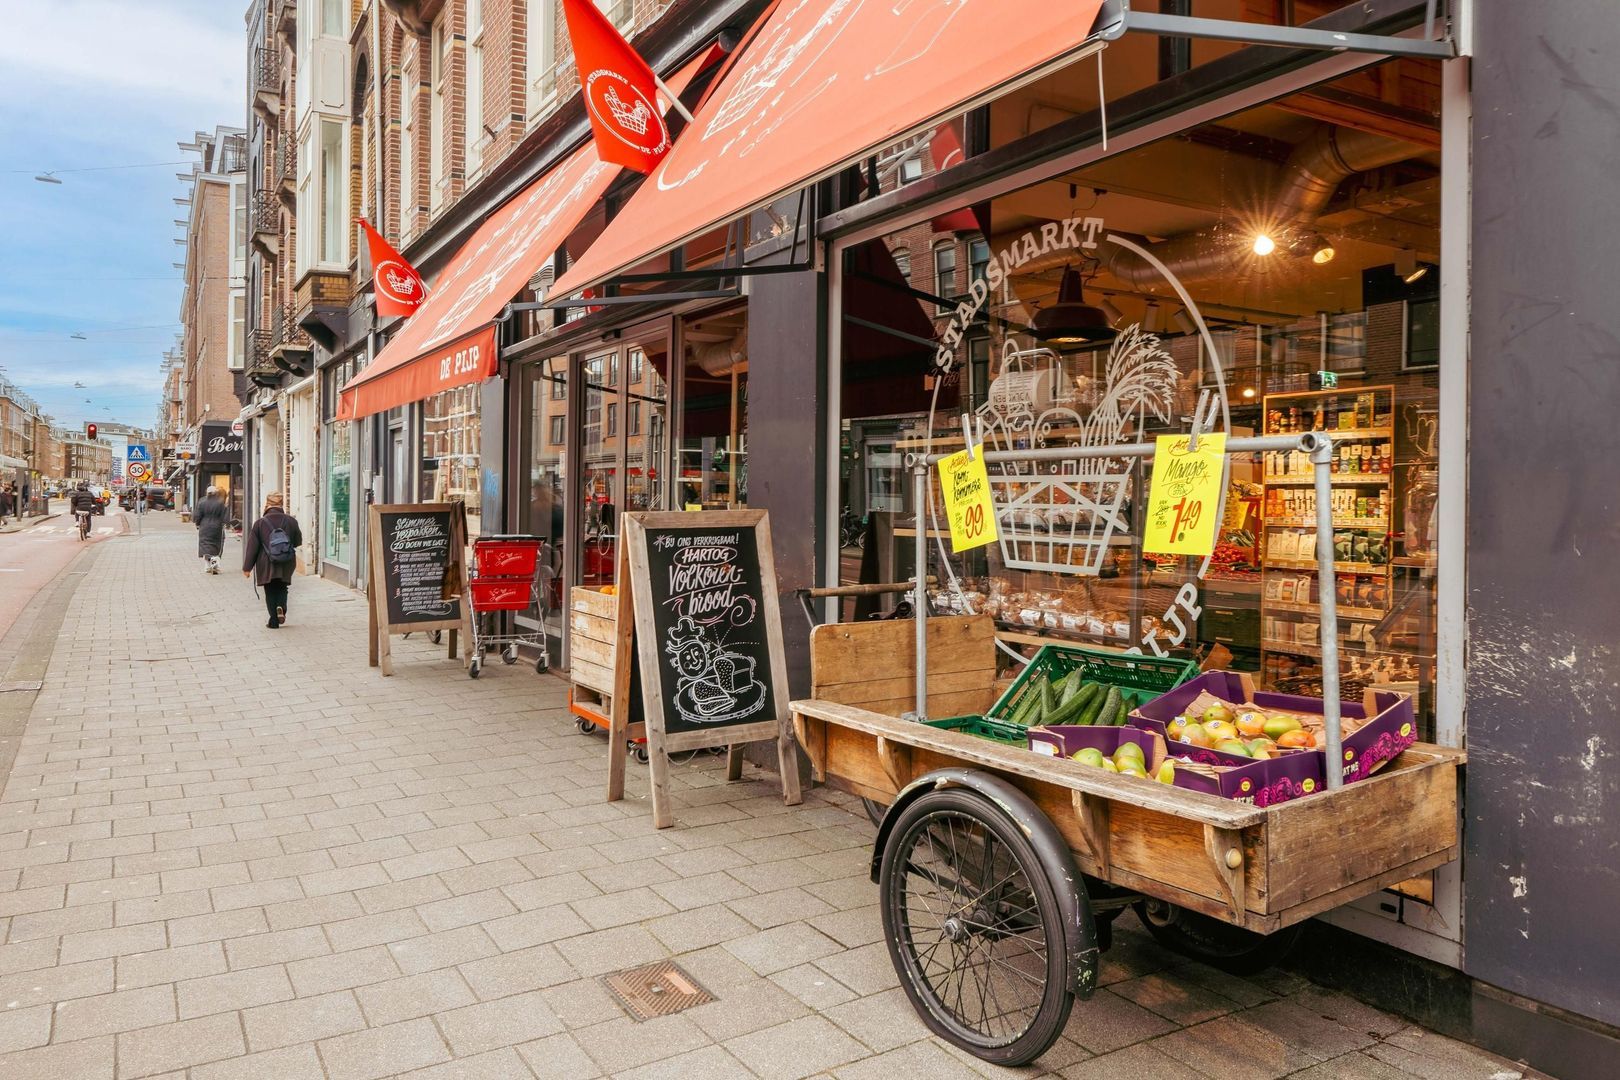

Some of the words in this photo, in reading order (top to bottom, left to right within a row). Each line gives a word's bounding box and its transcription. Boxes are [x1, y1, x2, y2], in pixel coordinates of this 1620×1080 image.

[936, 217, 1104, 373] STADSMARKT
[440, 357, 451, 380] DE
[454, 345, 480, 374] PIJP
[131, 466, 144, 474] 30
[1162, 458, 1208, 485] Mango
[393, 541, 405, 550] ZO
[405, 540, 422, 549] DOEN
[677, 536, 691, 546] ONS
[682, 547, 730, 563] HARTOG
[688, 584, 736, 616] brood
